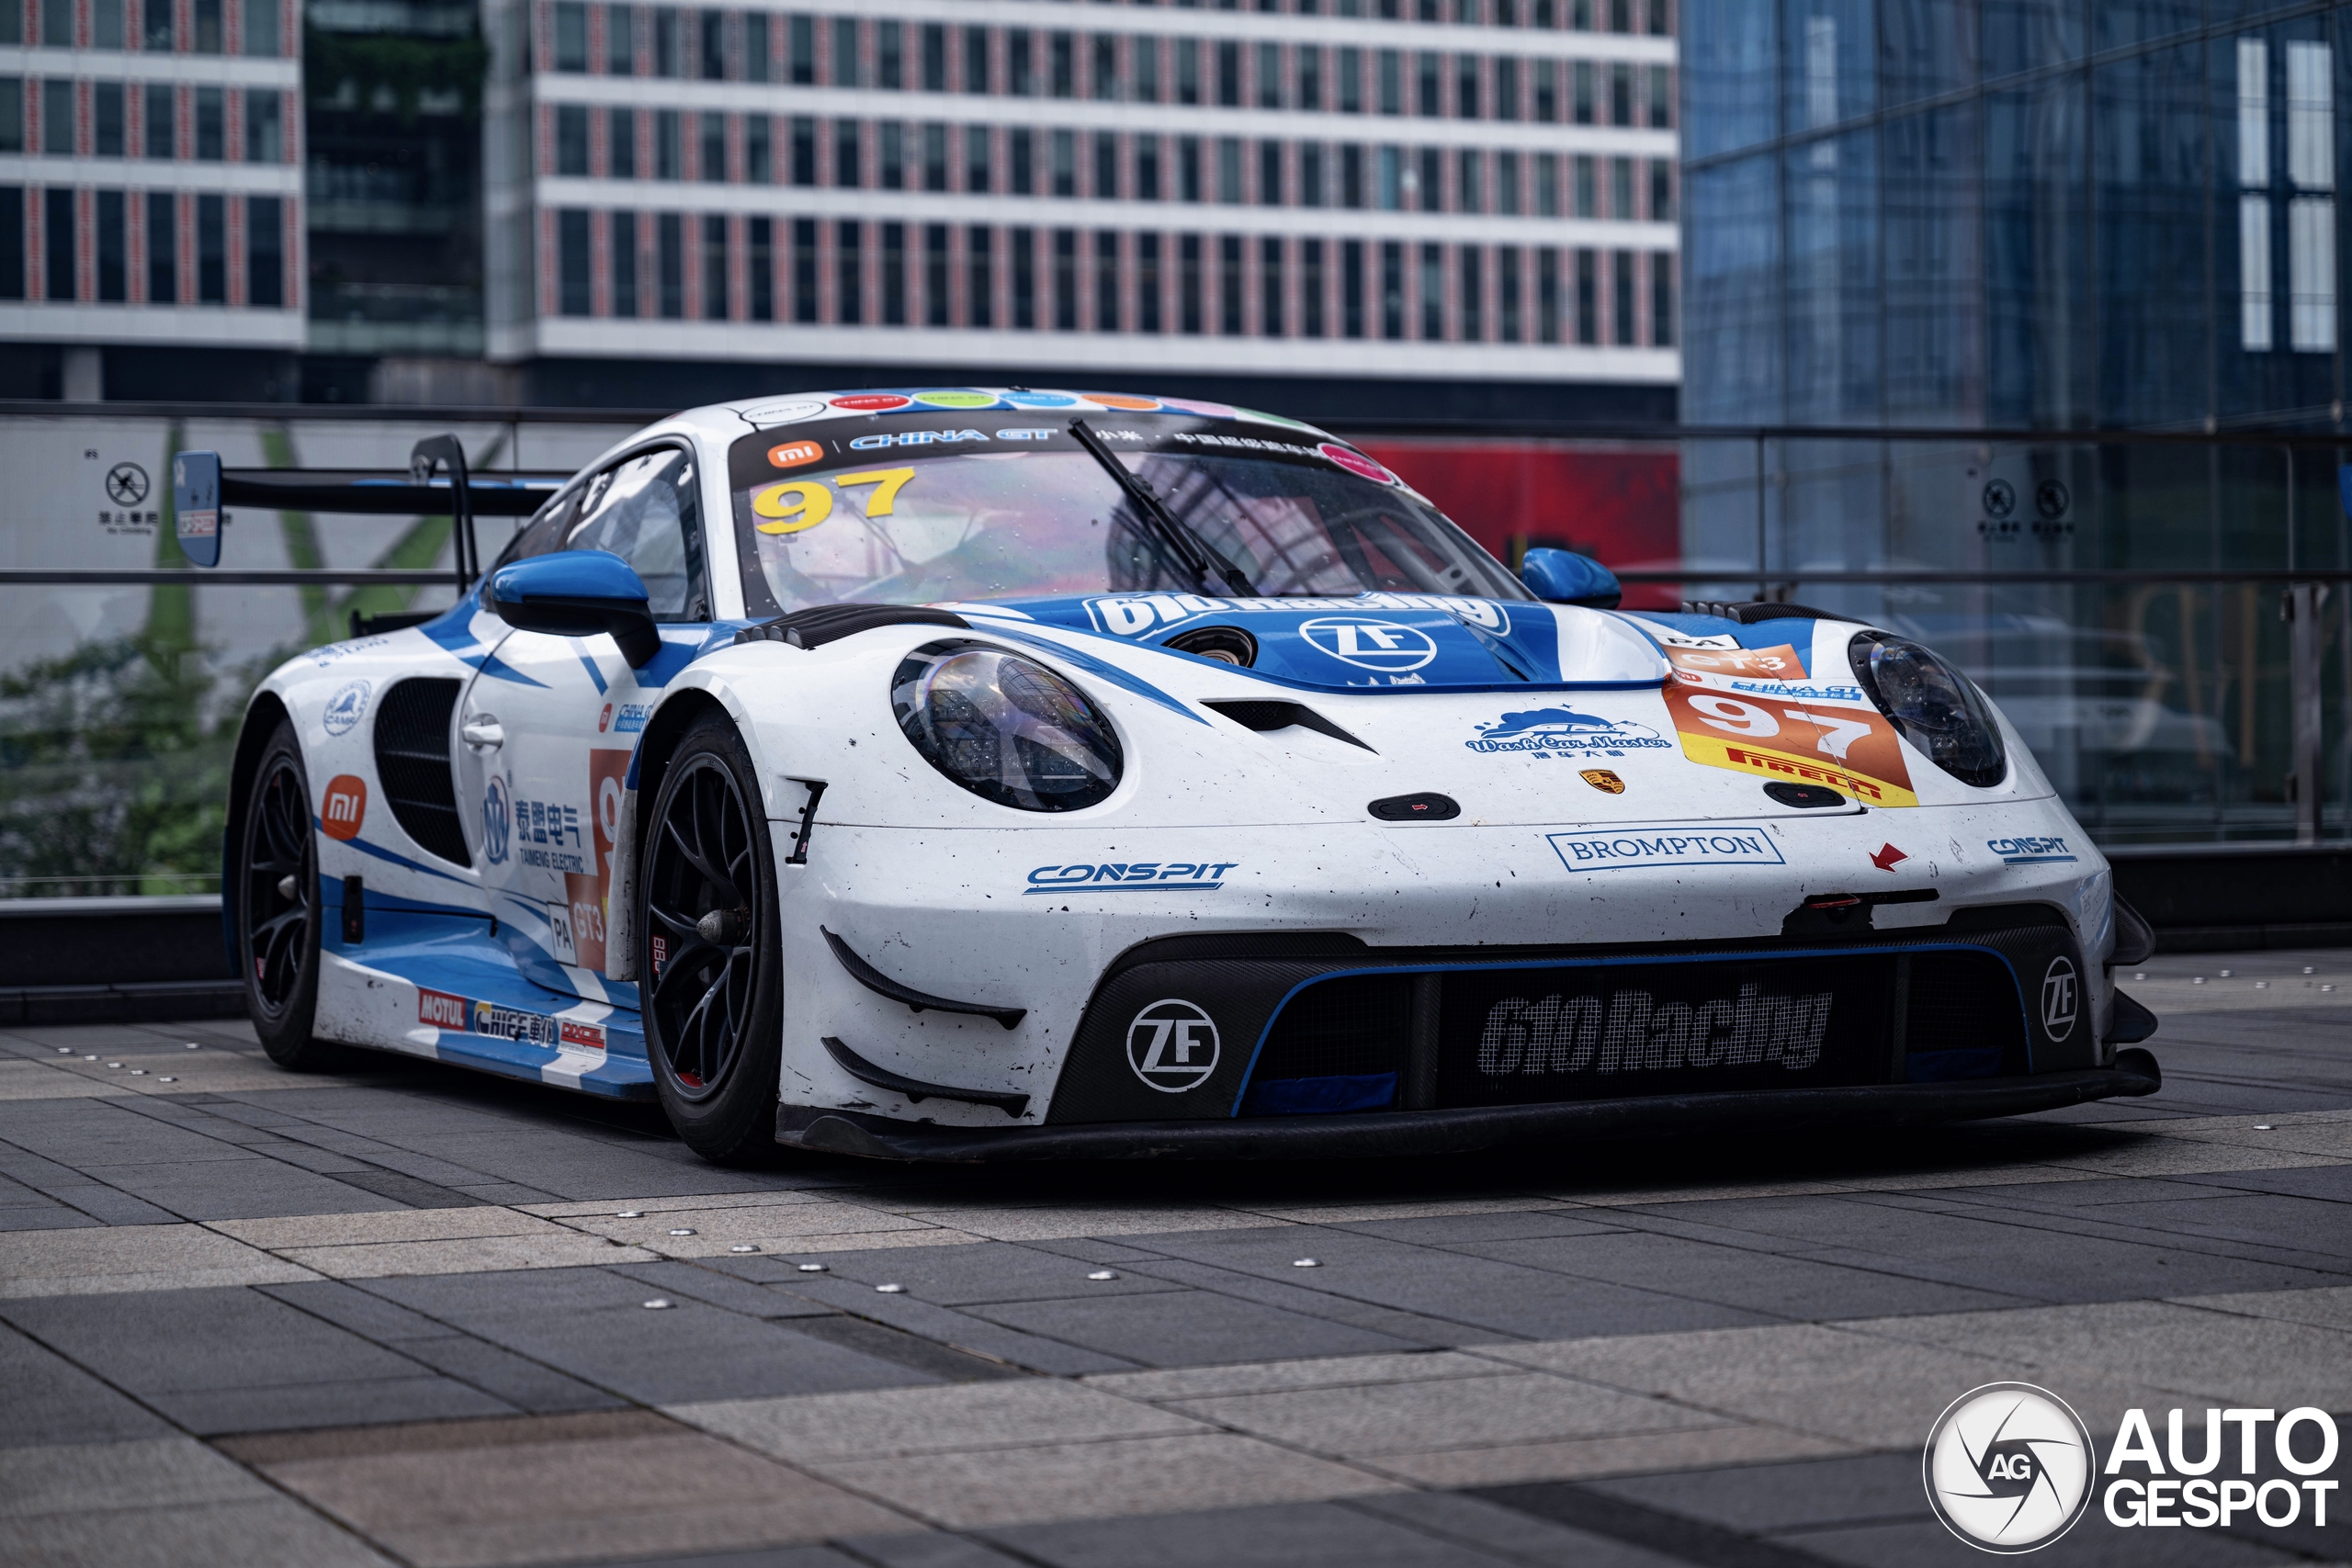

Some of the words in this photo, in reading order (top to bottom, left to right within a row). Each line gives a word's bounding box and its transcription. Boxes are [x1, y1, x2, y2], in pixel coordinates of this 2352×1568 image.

[849, 428, 990, 450] CHINA
[996, 427, 1059, 442] GT
[753, 468, 916, 536] 97
[1667, 637, 1726, 647] PA
[1681, 653, 1786, 671] GT3
[1687, 694, 1872, 760] 97
[1465, 738, 1541, 752] Wash
[1539, 737, 1586, 750] Car
[1588, 736, 1673, 749] Master
[1725, 747, 1883, 800] PIRELLI
[514, 799, 582, 849] 泰盟电气
[1567, 836, 1764, 861] BROMPTON
[1986, 837, 2070, 856] CONSPIT
[519, 848, 550, 869] TAIMENG
[551, 852, 584, 874] ELECTRIC
[1026, 863, 1240, 885] CONSPIT
[553, 918, 573, 951] PA
[573, 901, 605, 943] GT3
[421, 993, 465, 1027] MOTUL
